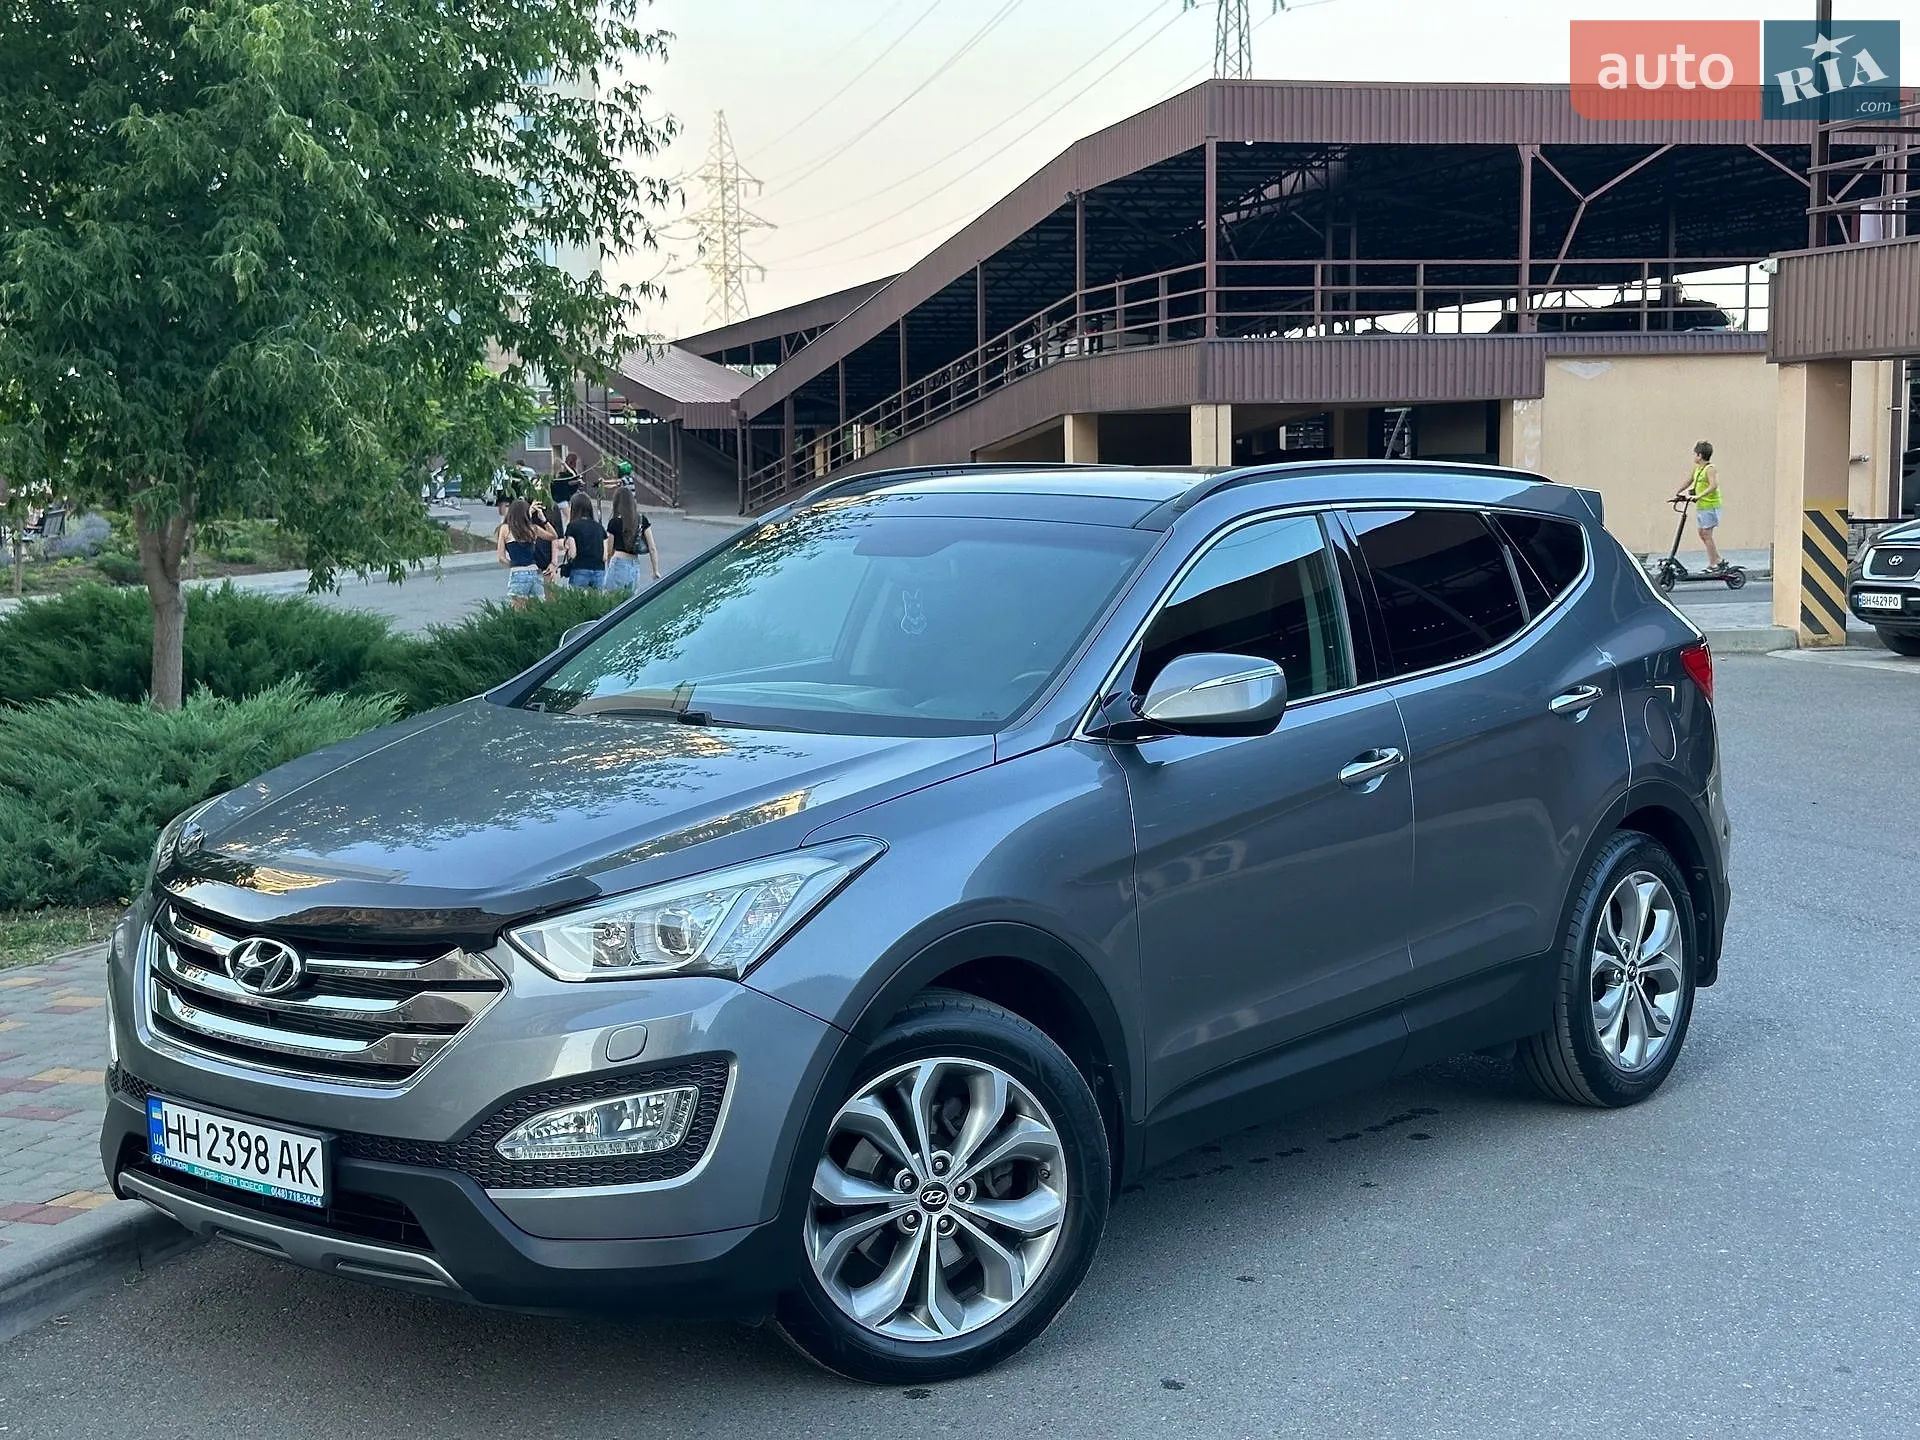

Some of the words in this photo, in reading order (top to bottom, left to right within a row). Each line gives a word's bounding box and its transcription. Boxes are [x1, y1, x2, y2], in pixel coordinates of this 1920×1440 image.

[153, 1133, 164, 1147] UA
[164, 1110, 201, 1158] HH
[206, 1122, 270, 1175] 2398
[277, 1139, 319, 1188] AK
